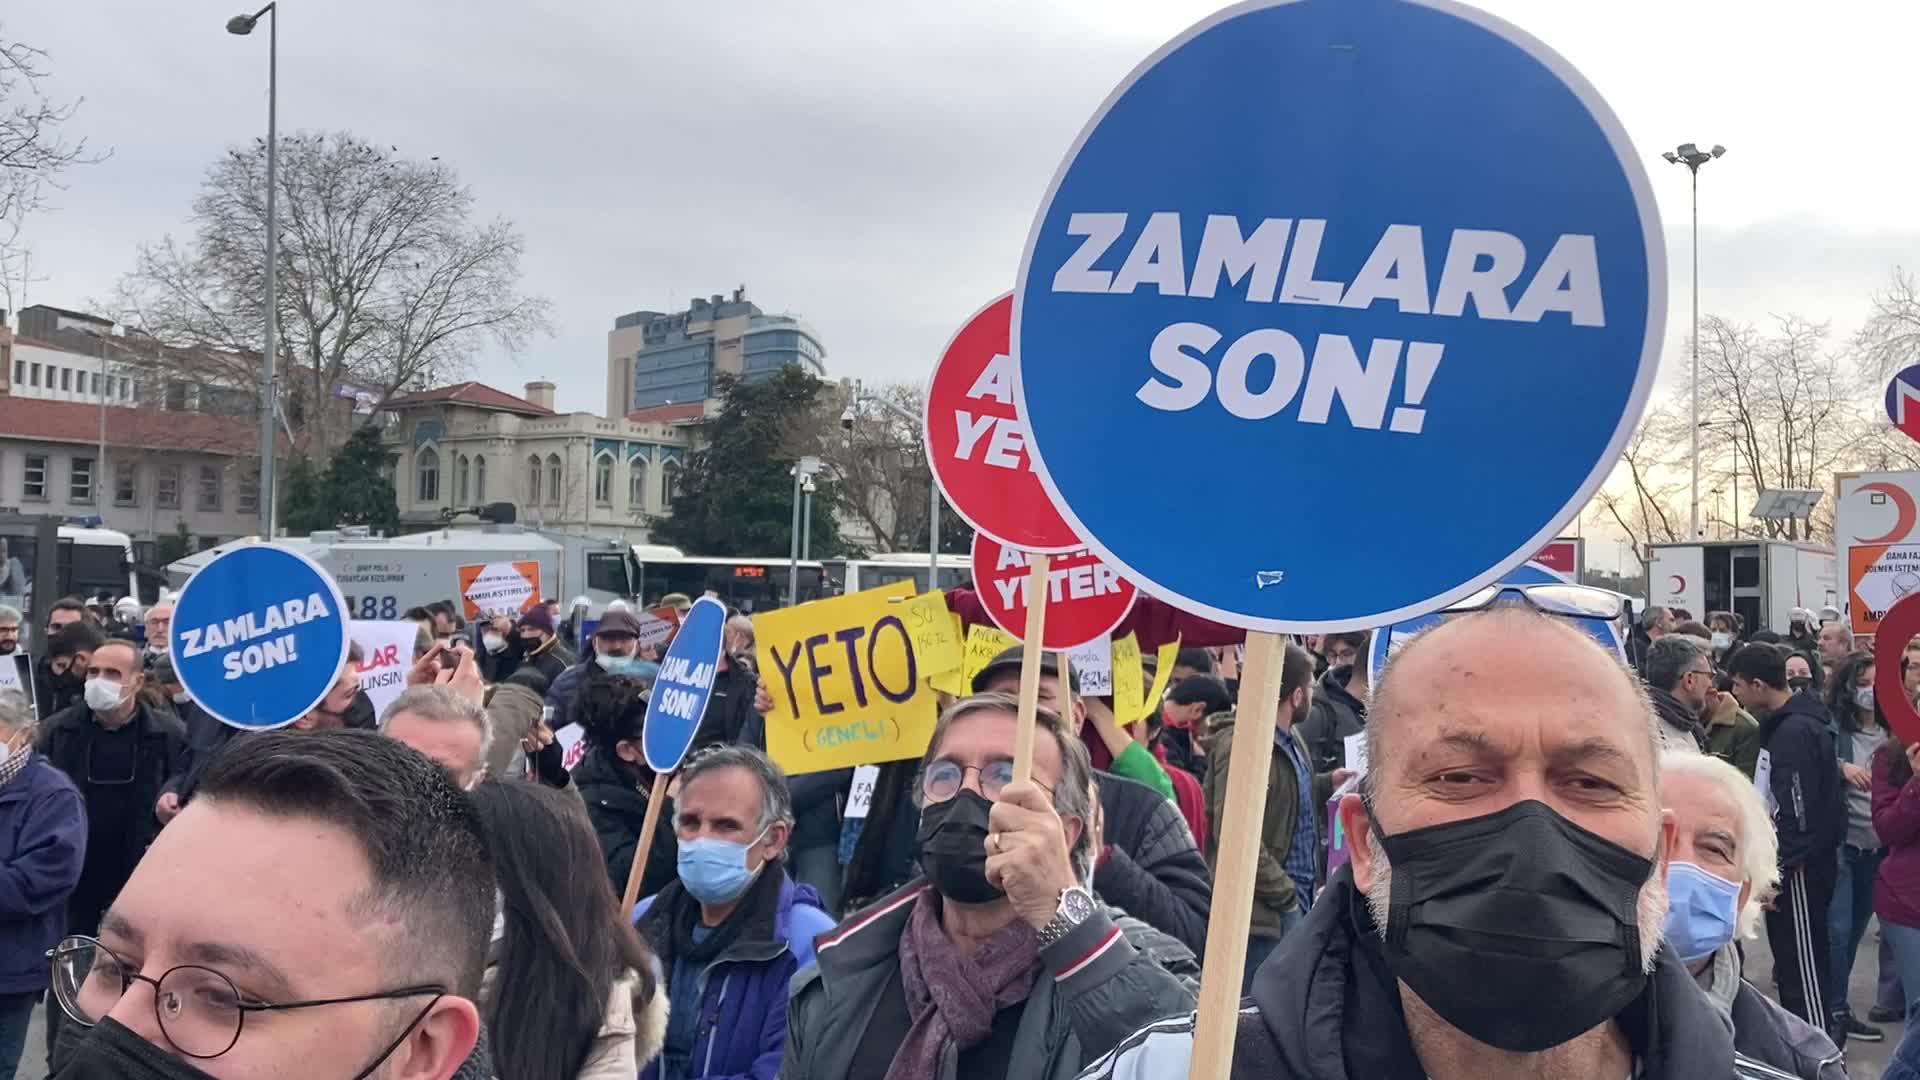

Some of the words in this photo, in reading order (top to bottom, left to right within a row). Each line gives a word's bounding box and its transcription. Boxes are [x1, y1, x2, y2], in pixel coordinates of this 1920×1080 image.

[1052, 212, 1605, 327] ZAMLARA
[1136, 322, 1446, 434] SON!
[180, 592, 330, 658] ZAMLARA
[911, 607, 933, 627] SU
[223, 633, 298, 680] SON!
[355, 644, 401, 673] LAR
[769, 615, 917, 720] YETO
[360, 671, 403, 692] LINSIN
[658, 687, 699, 721] SON!
[857, 782, 873, 793] FA
